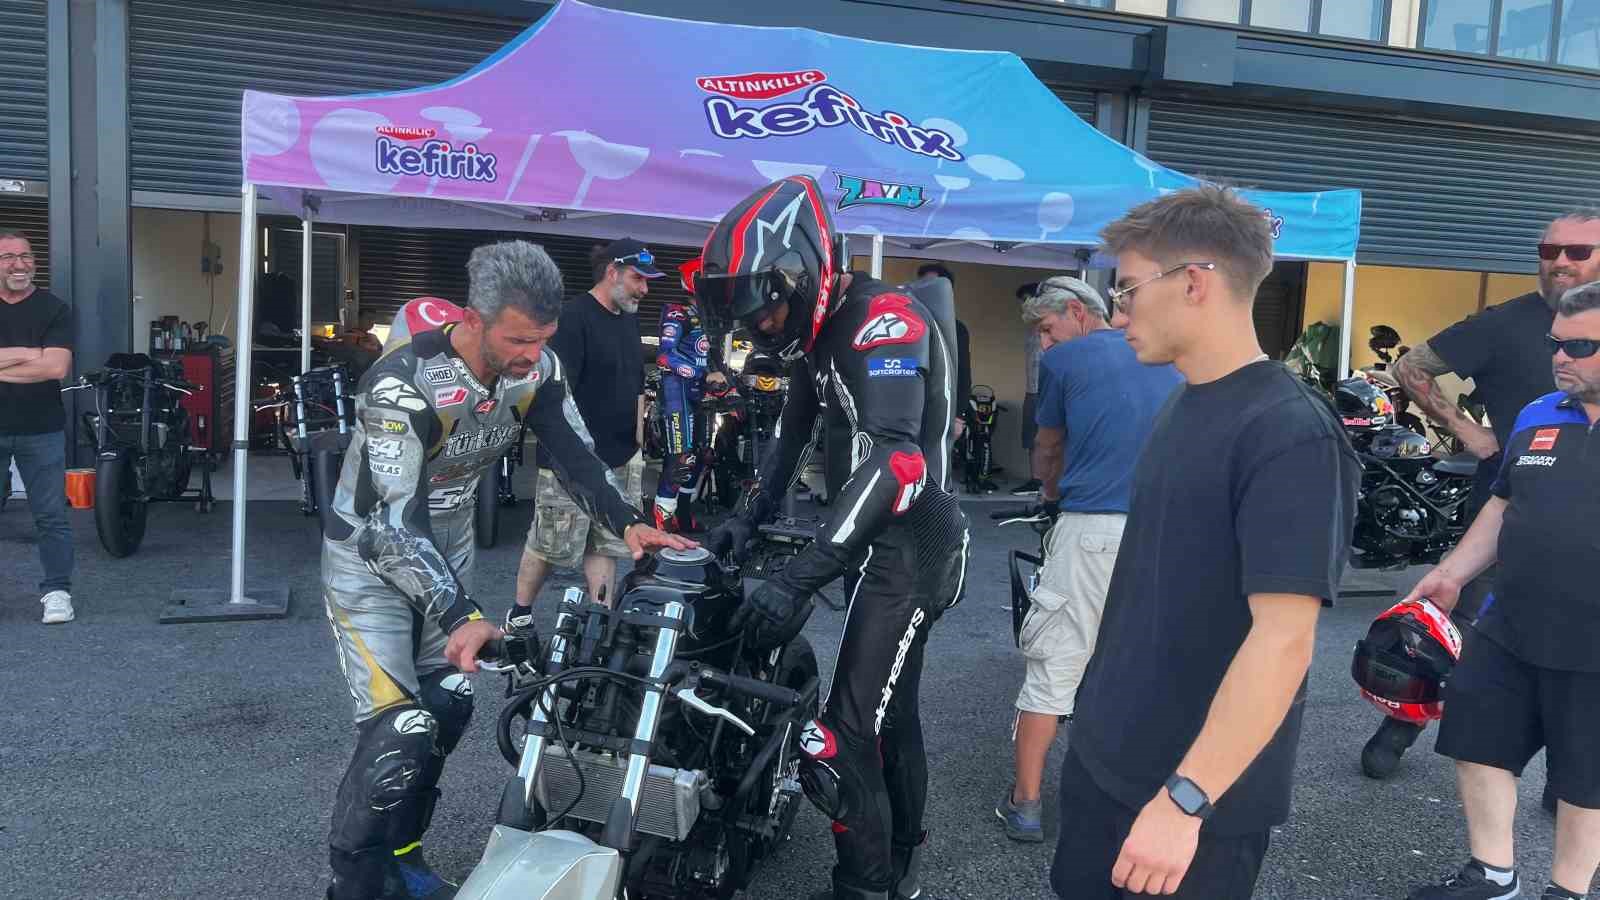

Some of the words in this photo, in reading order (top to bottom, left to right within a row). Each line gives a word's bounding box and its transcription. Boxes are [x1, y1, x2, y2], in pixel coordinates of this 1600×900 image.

[701, 71, 817, 93] ALTINKILIÇ
[703, 83, 965, 161] kefirix
[376, 137, 497, 182] kefirix
[427, 367, 454, 381] SHOEI
[874, 607, 925, 735] alpinestars
